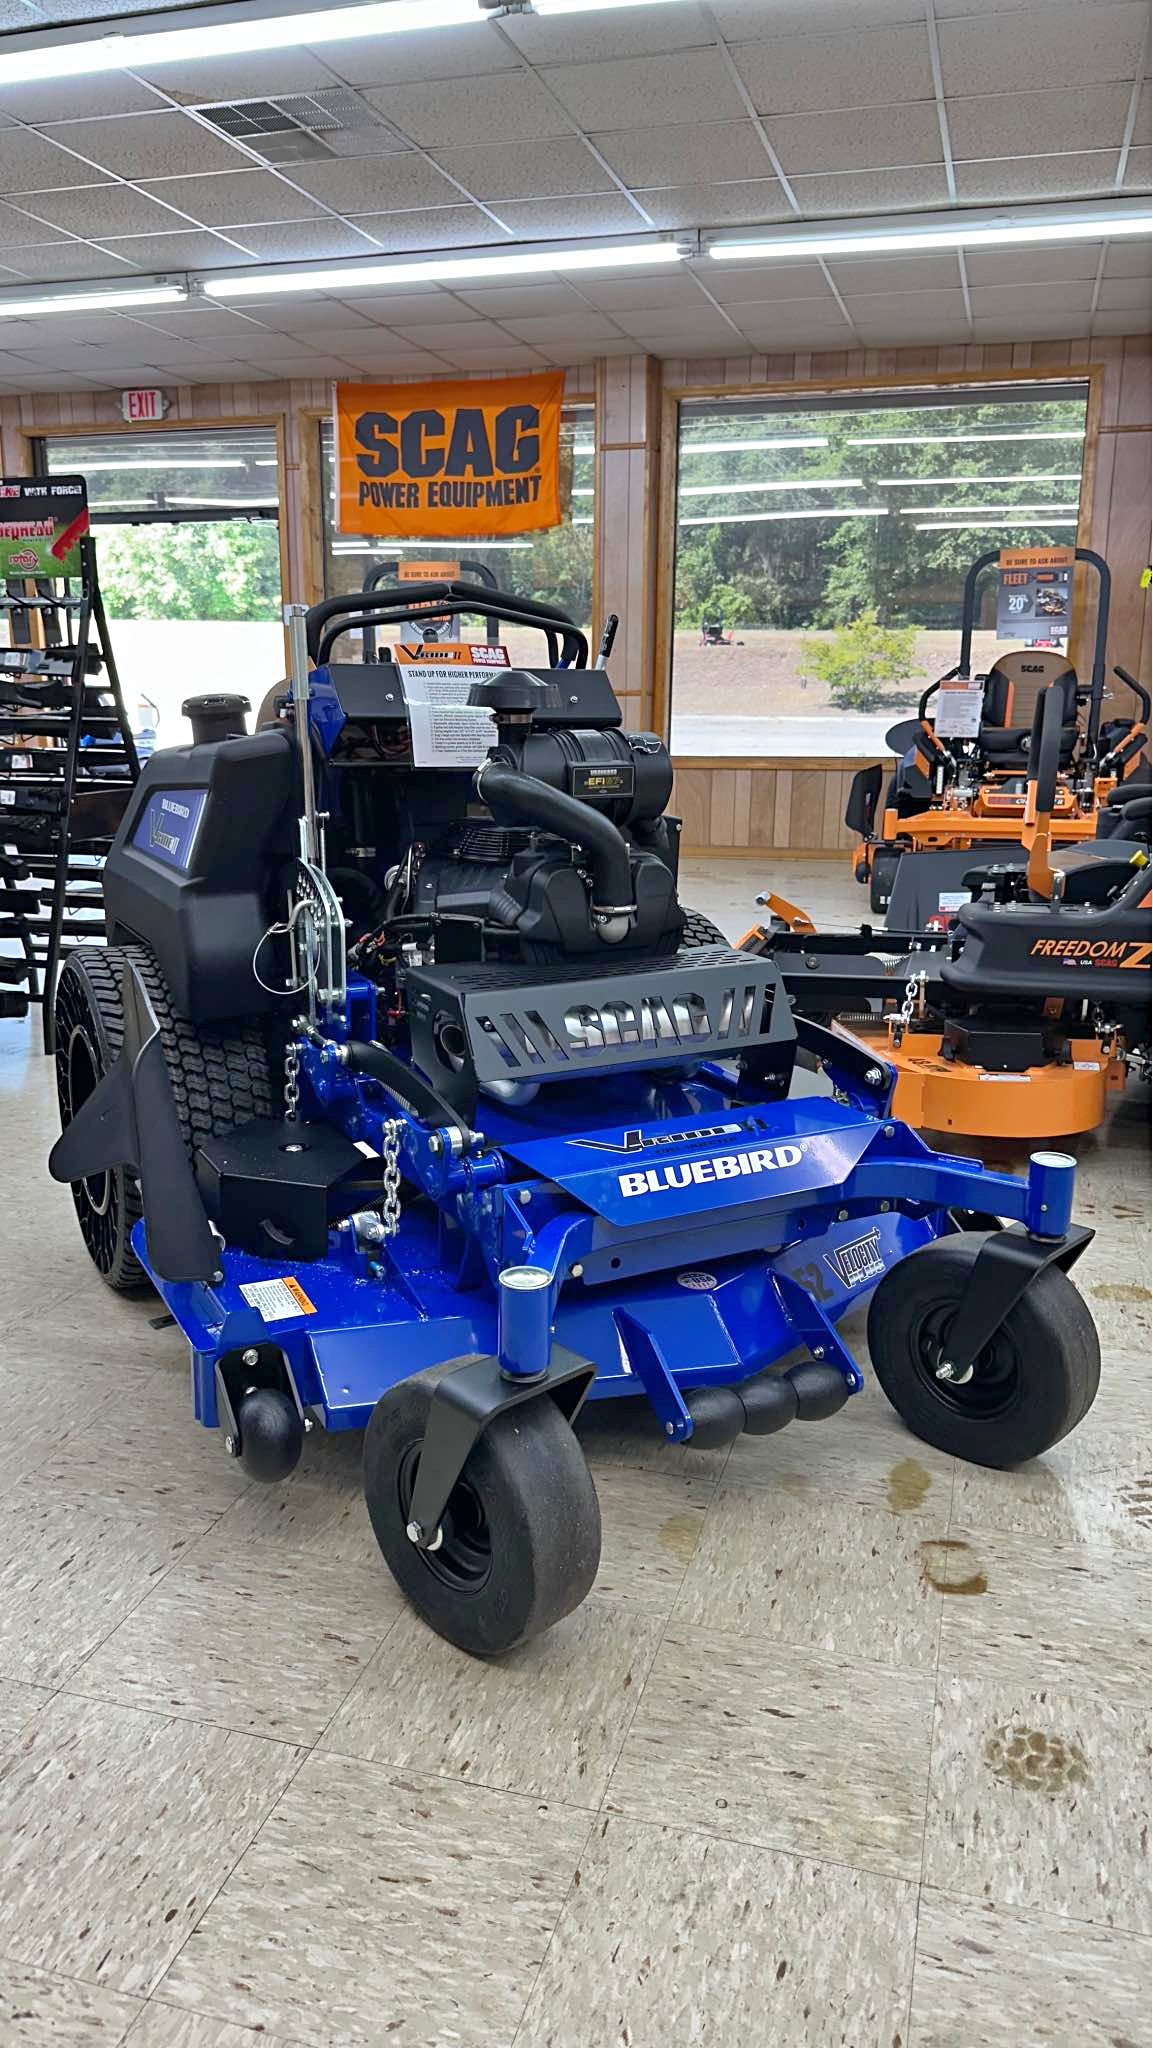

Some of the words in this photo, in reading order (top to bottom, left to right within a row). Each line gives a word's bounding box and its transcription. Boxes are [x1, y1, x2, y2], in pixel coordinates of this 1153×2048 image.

[127, 391, 156, 418] EXIT
[355, 404, 540, 478] SCAG
[358, 481, 419, 508] POWER
[427, 475, 542, 508] EQUIPMENT
[470, 646, 505, 660] SCAG
[408, 670, 427, 678] STAND
[563, 992, 712, 1058] SCAG
[823, 1227, 881, 1289] VELOCITY
